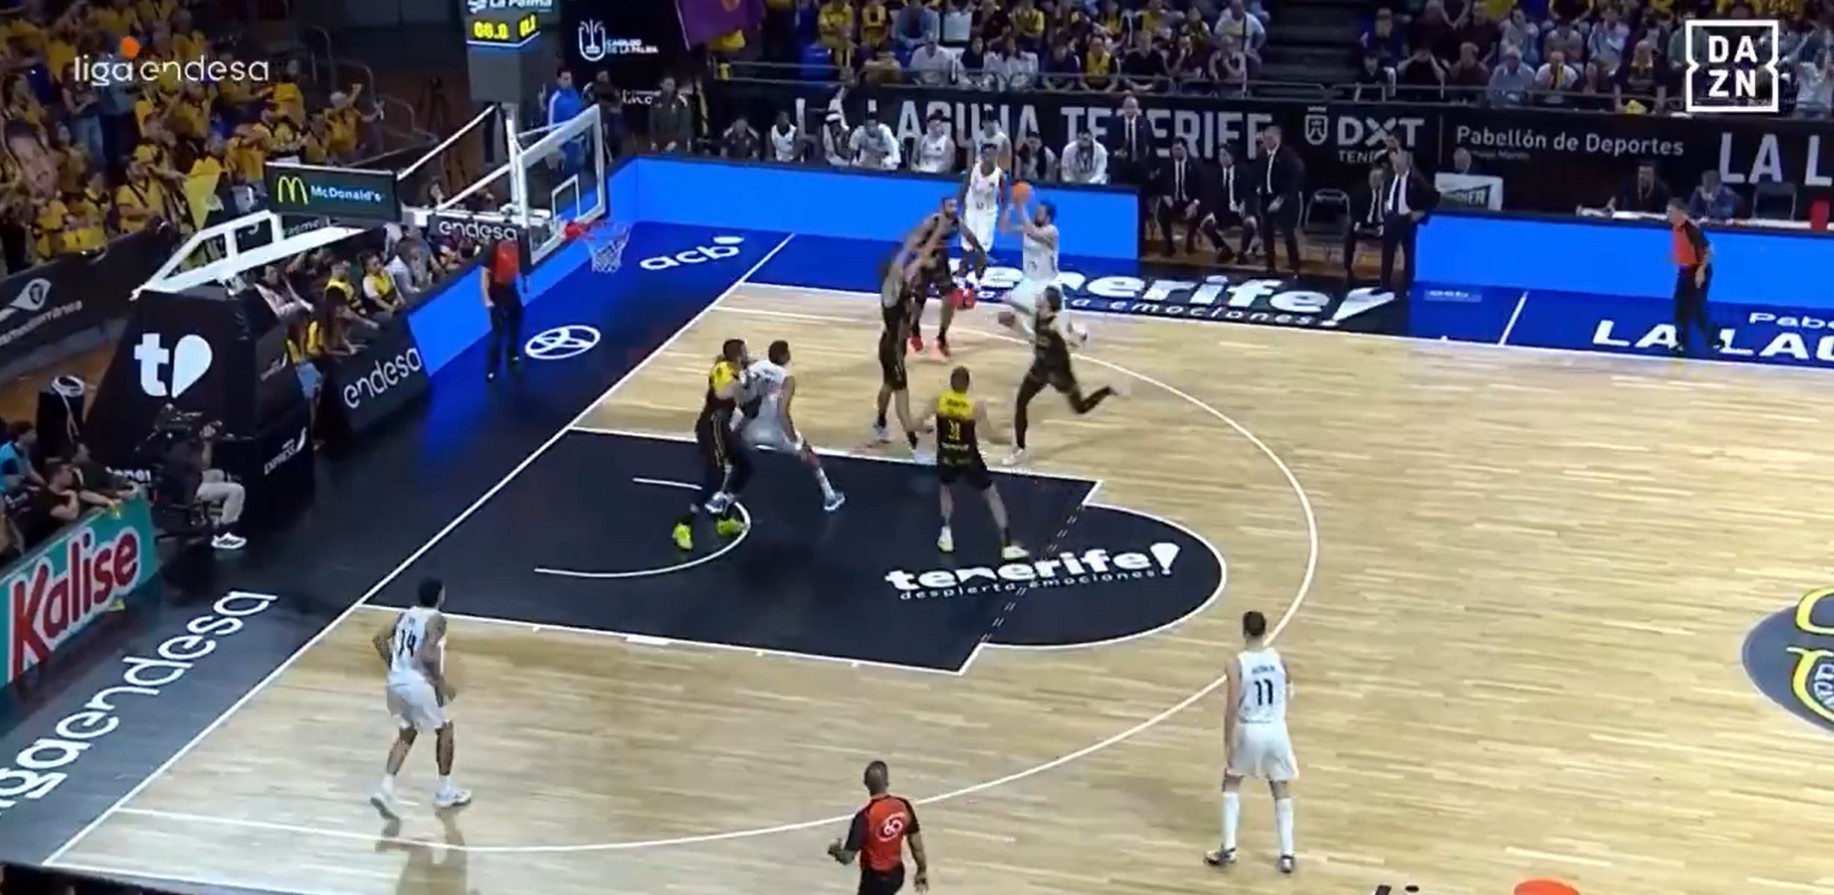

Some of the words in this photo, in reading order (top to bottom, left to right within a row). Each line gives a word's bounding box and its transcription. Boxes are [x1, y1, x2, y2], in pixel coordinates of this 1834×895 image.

[1337, 116, 1425, 147] DXT
[1456, 125, 1547, 149] Pabellón
[1553, 132, 1579, 151] de
[1586, 133, 1684, 157] Deportes
[1719, 132, 1782, 184] LA
[310, 185, 382, 202] McDonald's
[438, 221, 518, 241] endesa
[639, 245, 740, 271] acb
[343, 347, 422, 409] endesa
[900, 581, 1017, 600] despierta
[1029, 569, 1155, 589] emociones
[12, 532, 138, 683] Kalise
[399, 629, 416, 657] 14
[1253, 678, 1274, 706] 11
